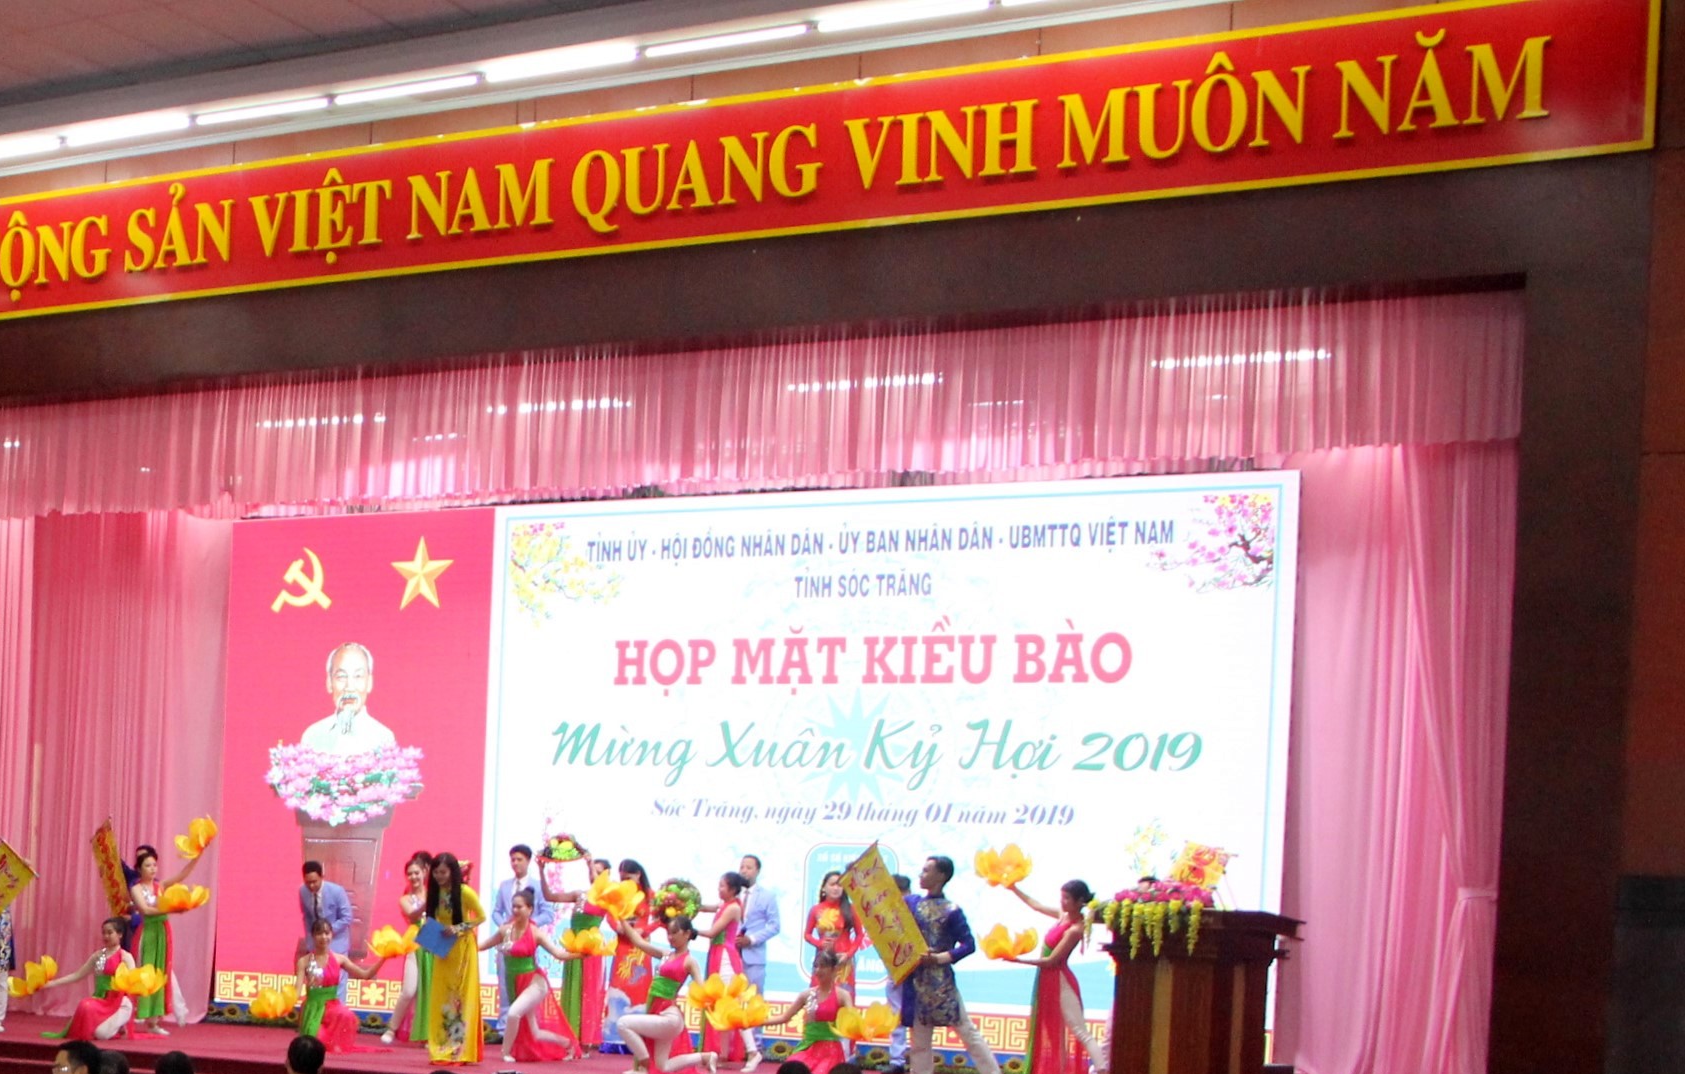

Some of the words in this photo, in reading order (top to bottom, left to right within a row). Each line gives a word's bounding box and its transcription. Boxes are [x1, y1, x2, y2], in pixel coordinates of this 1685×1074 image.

[124, 182, 233, 274] SẢN
[249, 166, 392, 265] VIỆT
[407, 156, 554, 240] NAM
[570, 122, 823, 234] QUANG
[842, 98, 1039, 188] VINH
[1056, 50, 1311, 171] MUÔN
[1332, 29, 1553, 141] NĂM
[587, 531, 622, 563] TỈNH
[627, 530, 648, 560] ỦY
[661, 532, 687, 567] HỘI
[692, 526, 735, 559] ĐỒNG
[740, 528, 785, 558] NHÂN
[791, 527, 823, 556] DÂN
[838, 522, 861, 554] ỦY
[866, 528, 899, 553] BAN
[905, 522, 953, 552] NHÂN
[958, 520, 993, 551] DÂN
[1009, 523, 1082, 549] UBMTTQ
[1088, 515, 1129, 553] VIỆT
[1134, 519, 1174, 545] NAM
[794, 567, 832, 598] TỈNH
[838, 568, 870, 597] SÓC
[876, 568, 932, 597] TRĂNG
[614, 638, 716, 697] HỌP
[730, 622, 848, 695] MẶT
[861, 614, 997, 685] KIỀU
[1013, 619, 1133, 684] BÀO
[550, 718, 697, 787] Mừng
[705, 718, 852, 770] Xuân
[862, 716, 945, 790] Kỷ
[958, 717, 1061, 780] Hợi
[1072, 729, 1204, 773] 2019
[649, 798, 687, 818] Sóc
[764, 804, 818, 826] ngày
[822, 801, 853, 821] 29
[855, 801, 920, 828] tháng
[924, 802, 953, 823] 01
[956, 804, 1008, 825] năm
[1012, 803, 1075, 827] 2019
